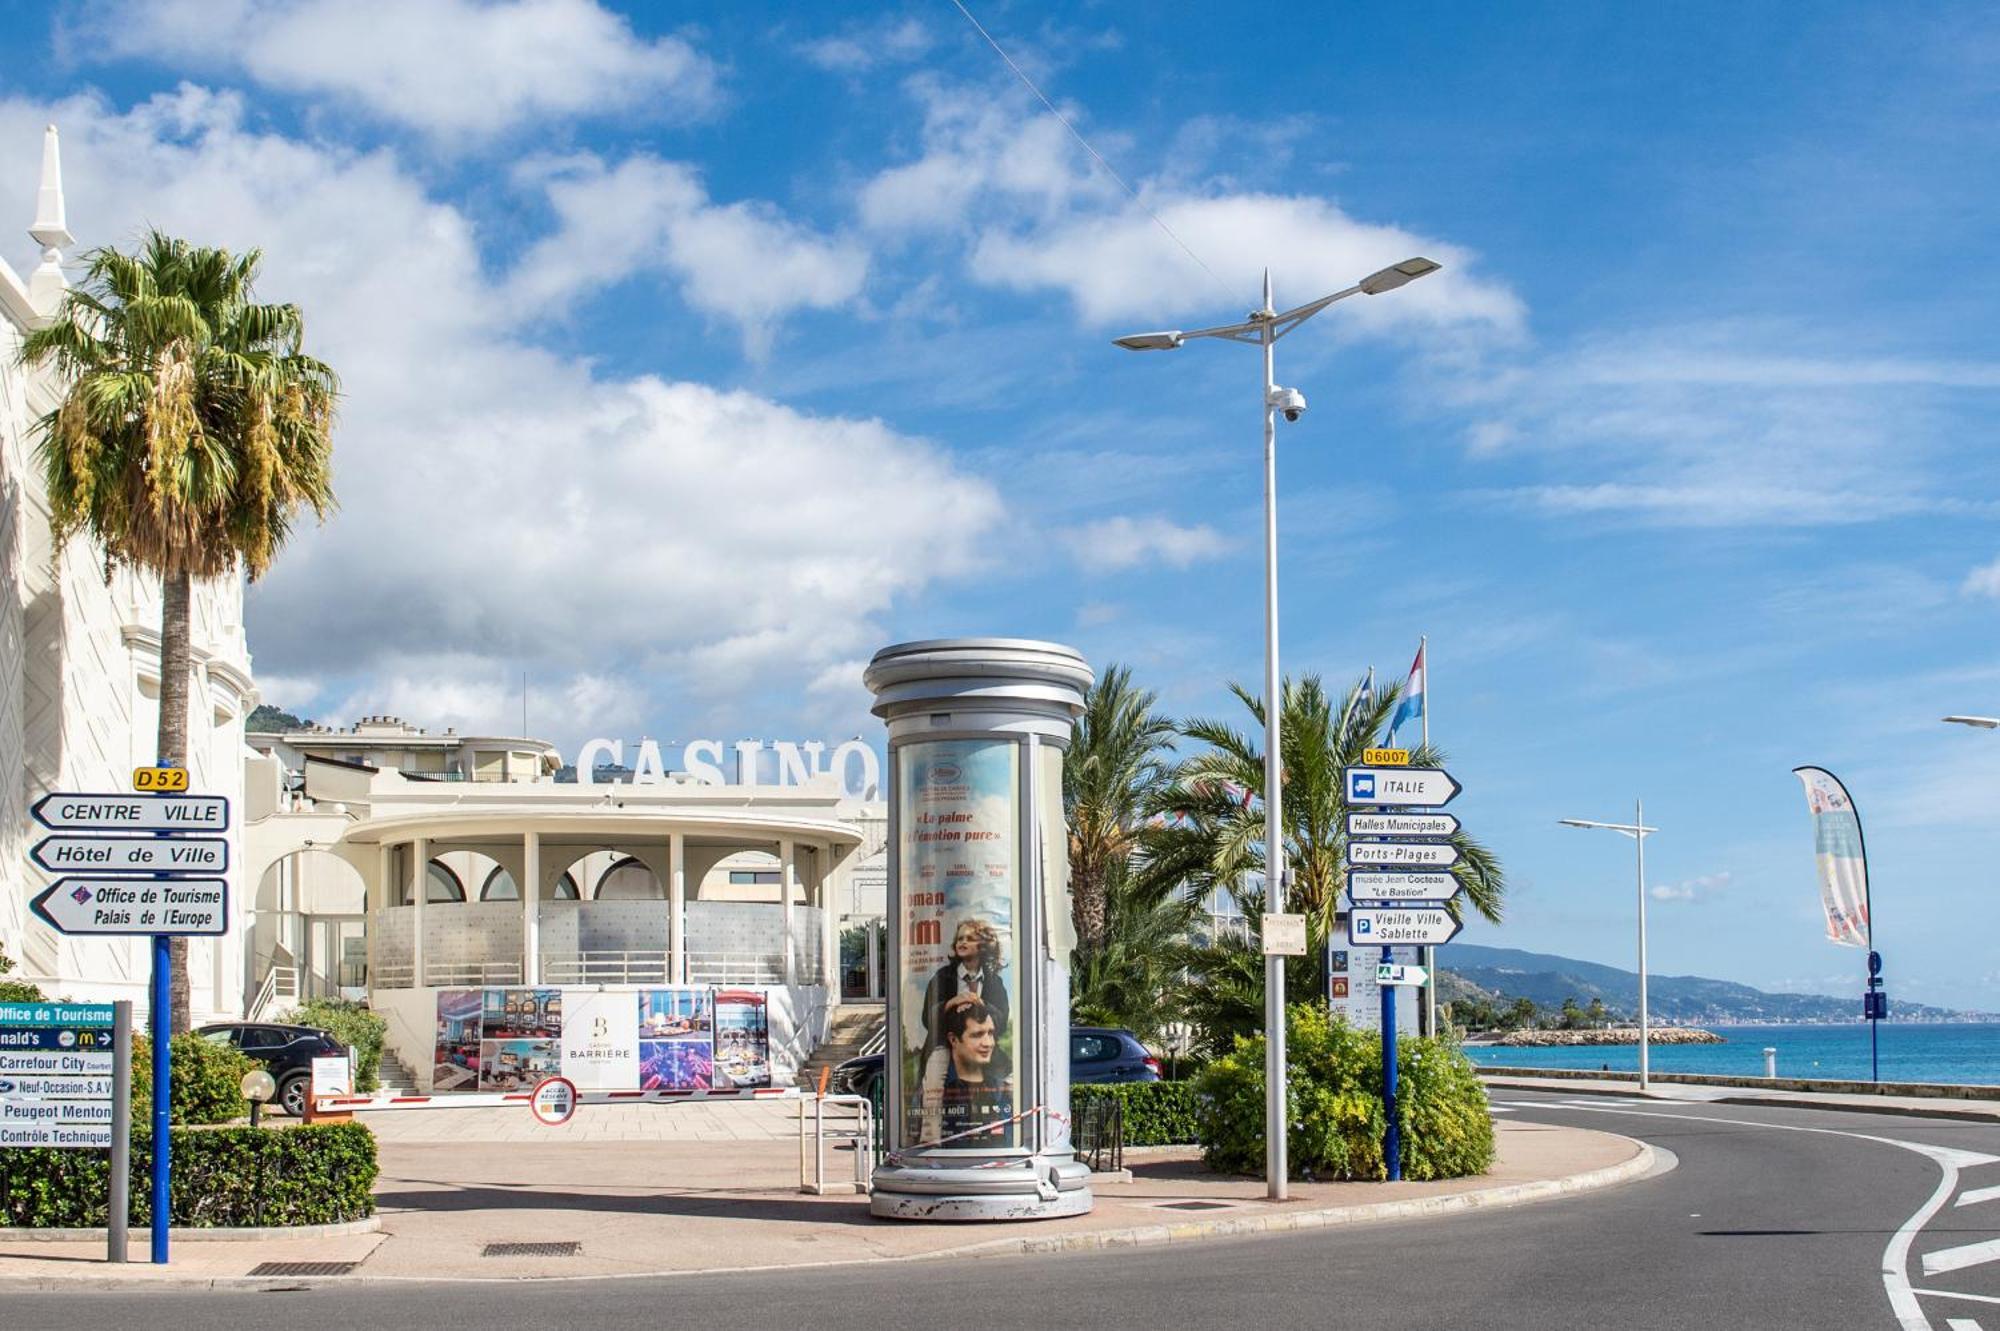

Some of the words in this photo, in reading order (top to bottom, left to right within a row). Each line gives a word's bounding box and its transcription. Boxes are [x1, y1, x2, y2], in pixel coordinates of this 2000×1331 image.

[576, 738, 880, 802] CASINO
[1384, 781, 1425, 794] ITALIE
[61, 804, 142, 821] CENTRE
[164, 805, 218, 822] VILLE
[938, 811, 973, 825] palme
[1354, 818, 1385, 831] Halles
[1386, 819, 1446, 833] Municipales
[56, 846, 111, 862] Hôtel
[128, 847, 153, 863] de
[171, 847, 215, 863] Ville
[1355, 848, 1437, 861] Ports-Plages
[1355, 875, 1383, 884] musée
[1386, 875, 1405, 884] Jean
[1408, 875, 1445, 884] Cocteau
[96, 888, 136, 904] Office
[140, 888, 157, 904] de
[163, 888, 221, 904] Tourisme
[94, 909, 130, 924] Palais
[141, 910, 155, 924] de
[163, 909, 212, 928] l'Europe
[1375, 913, 1411, 925] Vieille
[1417, 913, 1442, 925] Ville
[35, 1007, 50, 1021] de
[54, 1007, 113, 1021] Tourisme
[0, 1056, 57, 1069] Carrefour
[62, 1056, 85, 1072] City
[4, 1105, 58, 1120] Peugeot
[63, 1105, 112, 1118] Menton
[1, 1129, 49, 1142] Contrôle
[52, 1130, 111, 1145] Technique
